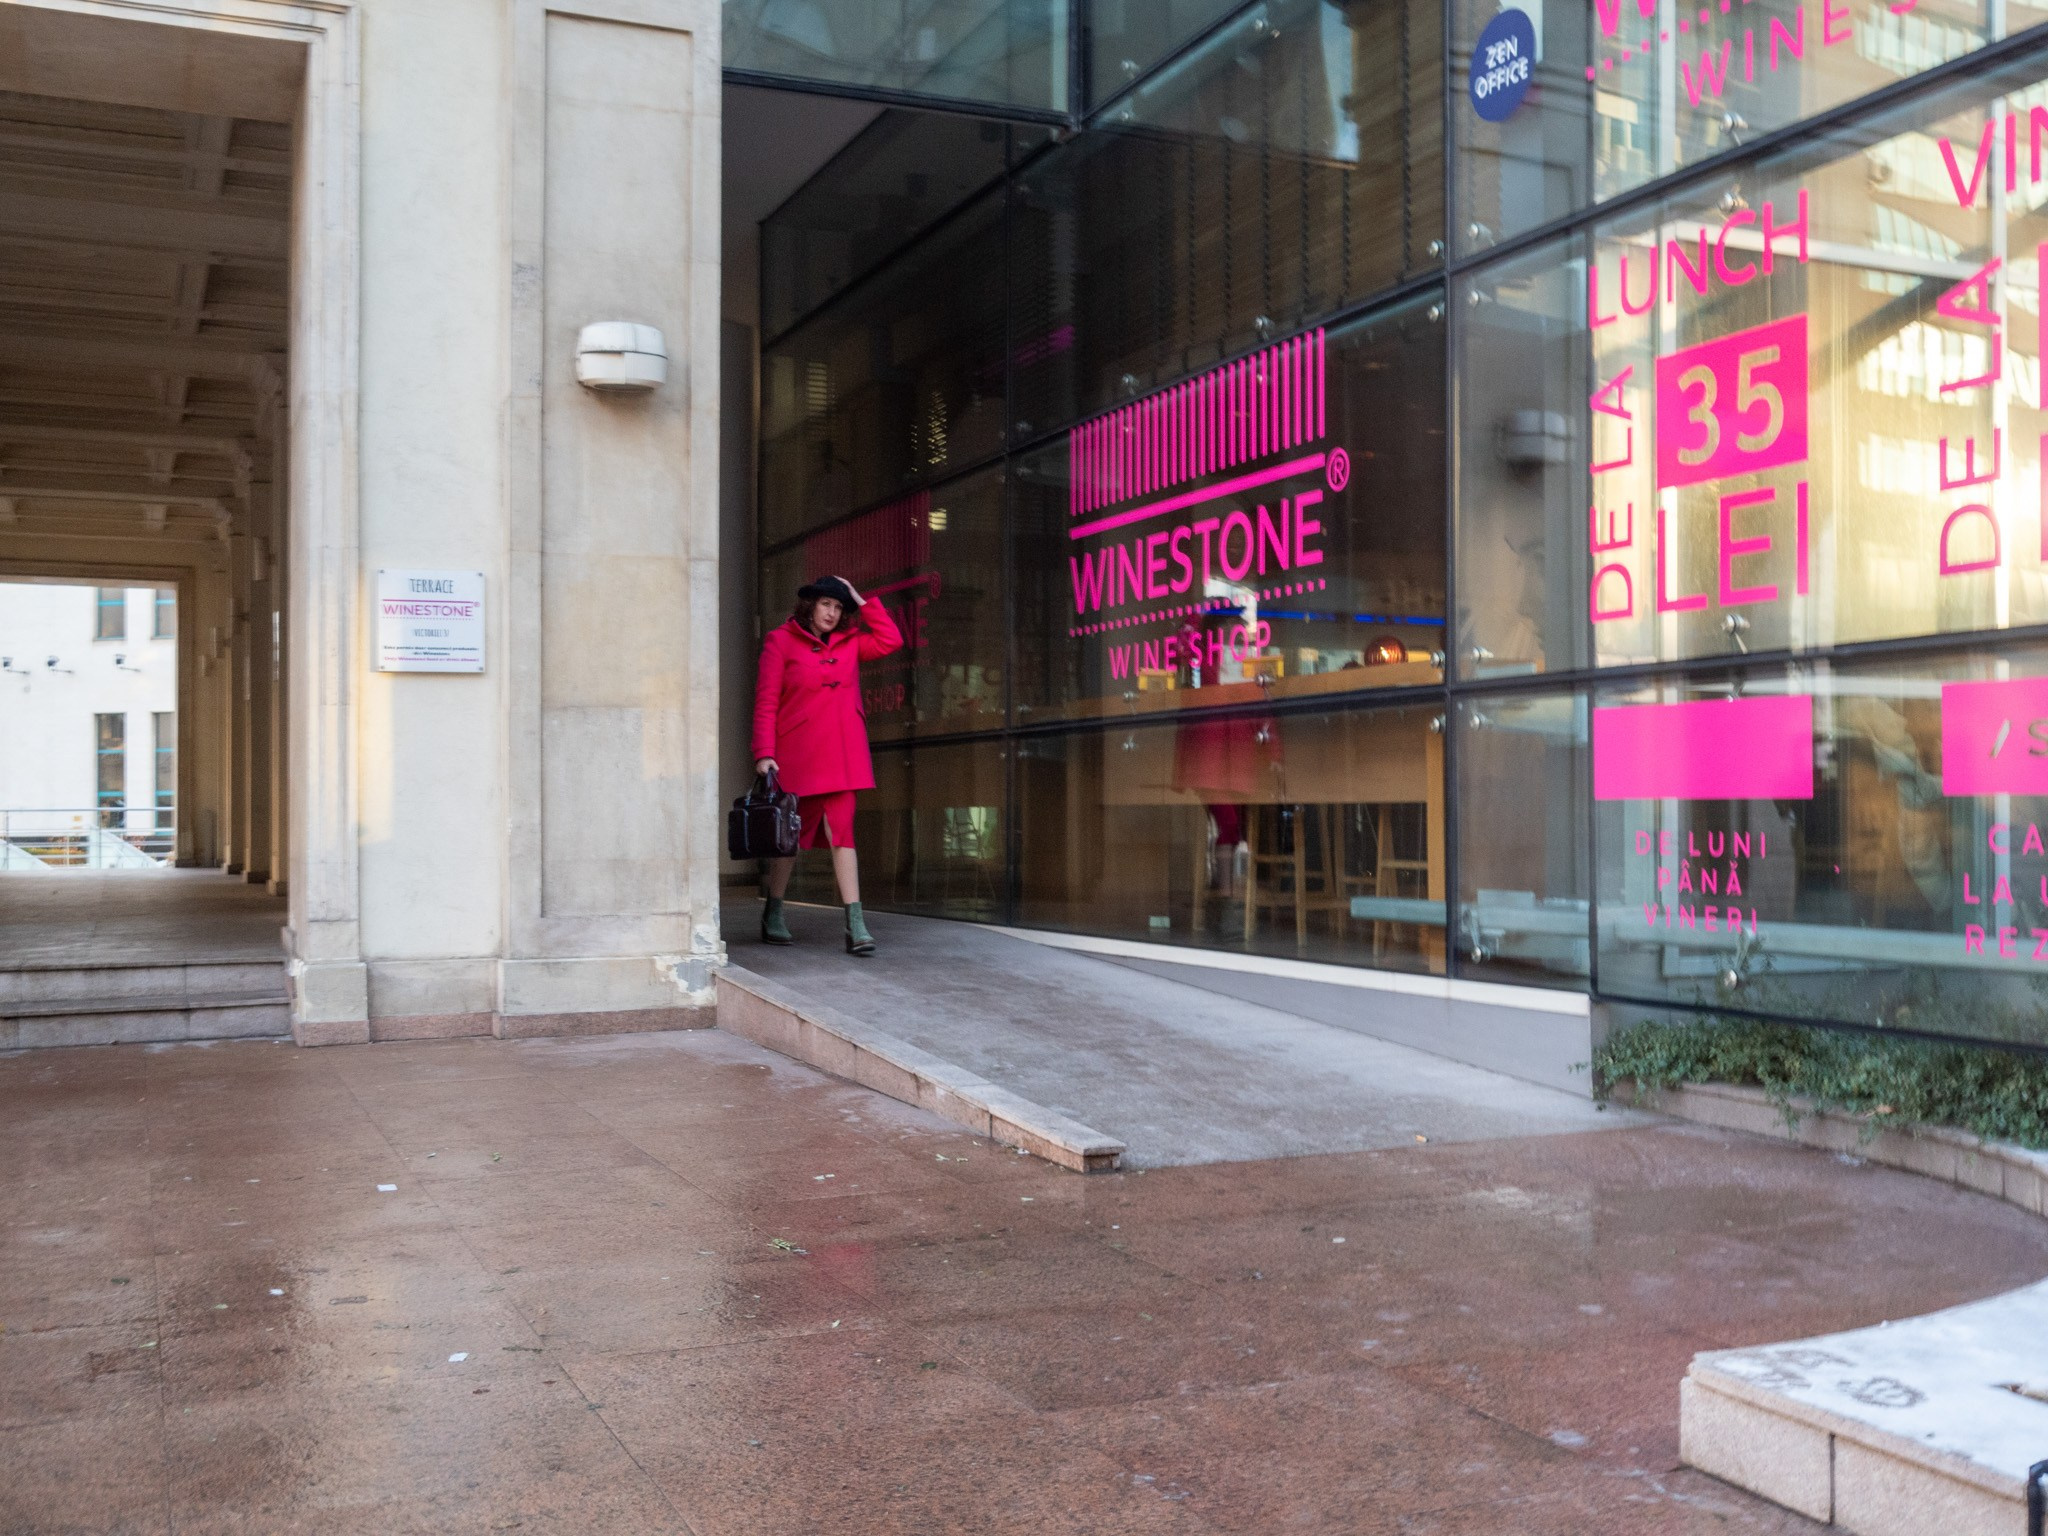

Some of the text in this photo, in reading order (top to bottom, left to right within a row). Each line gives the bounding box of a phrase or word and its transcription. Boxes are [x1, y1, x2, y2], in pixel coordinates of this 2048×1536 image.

[1474, 56, 1529, 99] OFFICE
[1485, 35, 1518, 69] ZEN
[1589, 189, 1808, 330] LUNCH
[1677, 344, 1784, 467] 35
[1937, 256, 2002, 576] DE LA
[1589, 364, 1634, 624] DE LA
[1657, 481, 1808, 615] LEI
[410, 578, 454, 594] TERRACE
[1108, 620, 1271, 680] WINE SHOP
[1635, 829, 1766, 860] DE LUNI
[1657, 858, 1742, 896] PÂNĂ
[1643, 901, 1757, 934] VINERI
